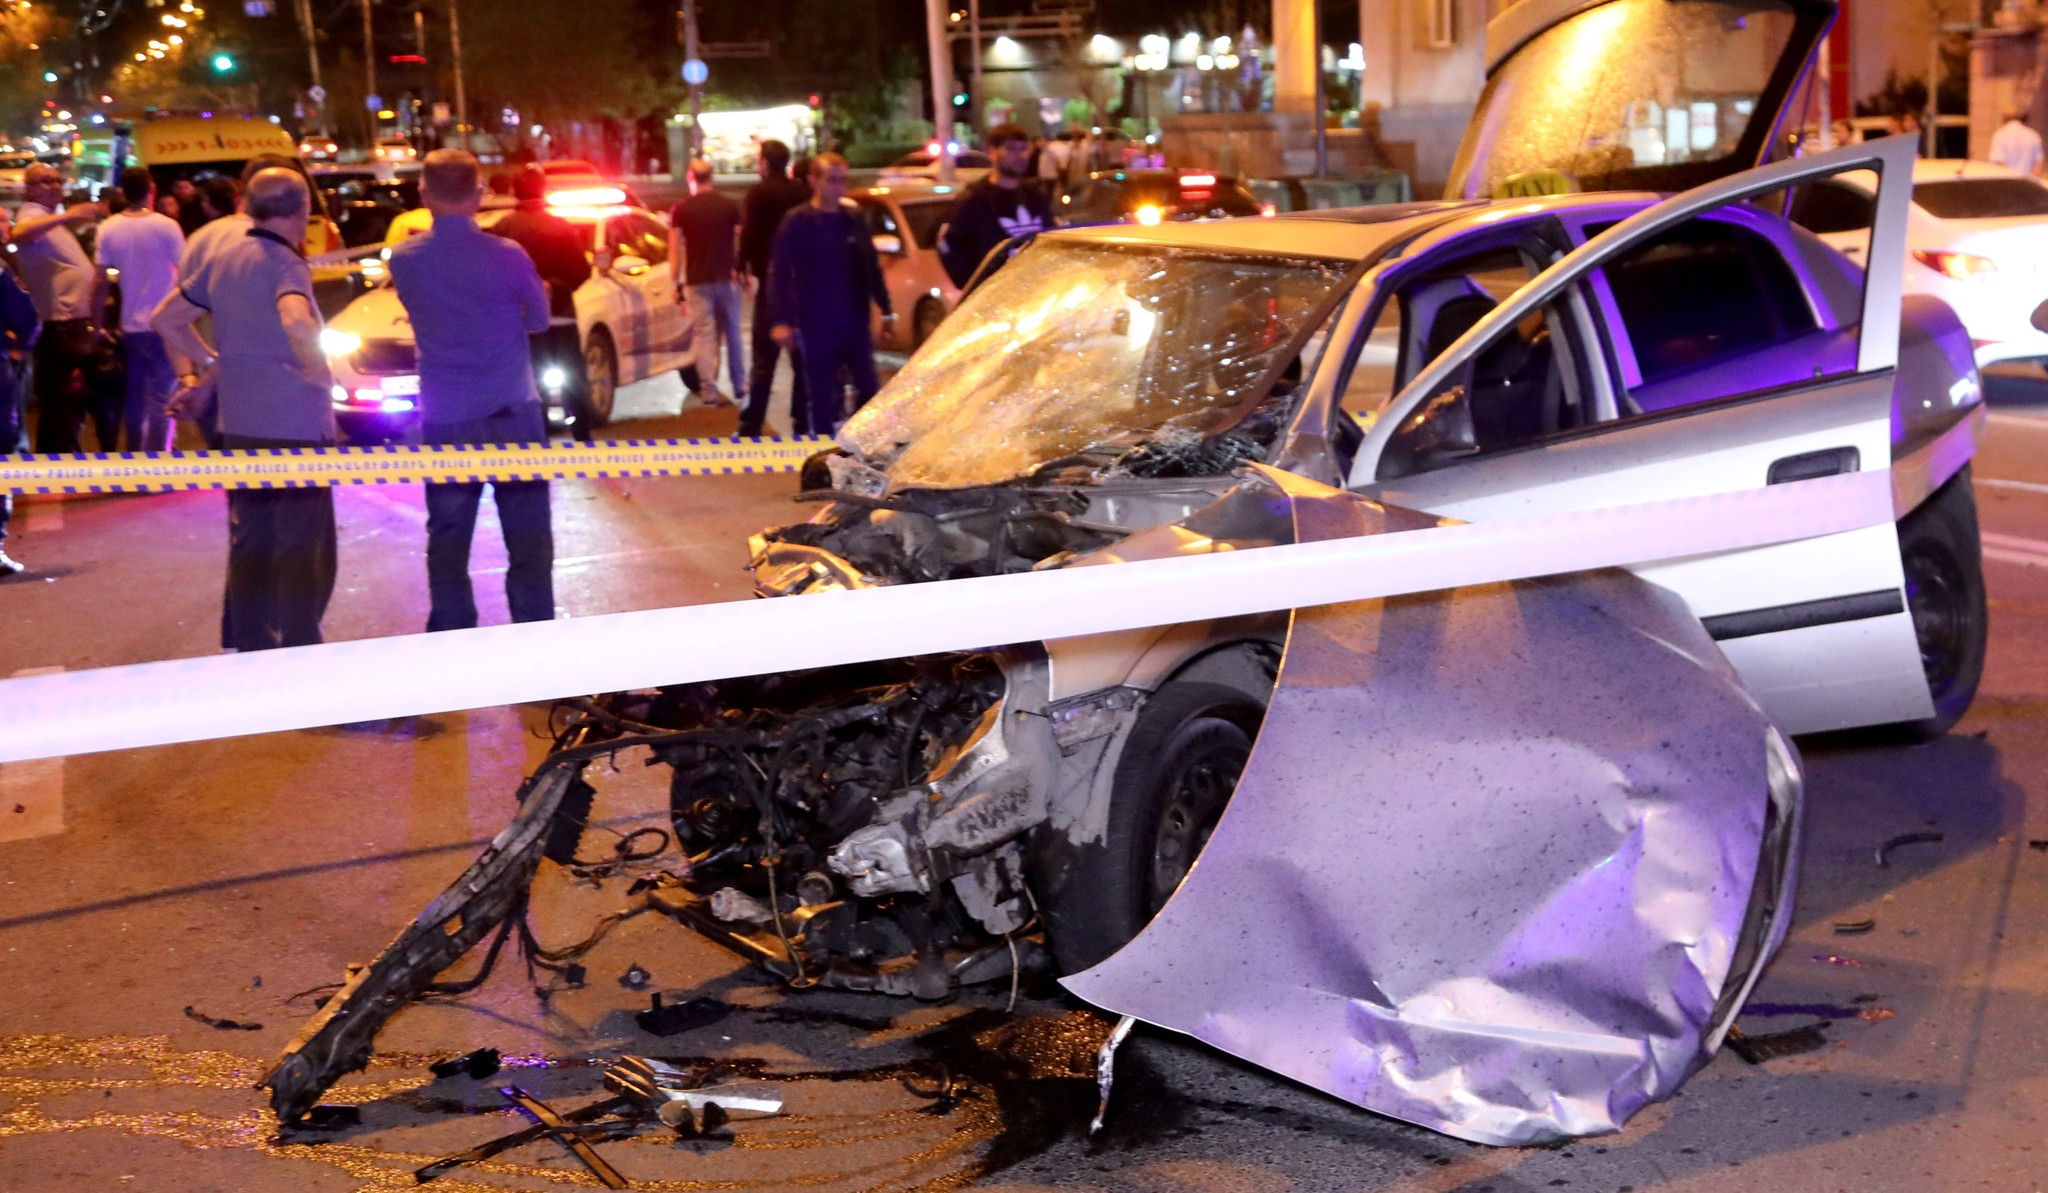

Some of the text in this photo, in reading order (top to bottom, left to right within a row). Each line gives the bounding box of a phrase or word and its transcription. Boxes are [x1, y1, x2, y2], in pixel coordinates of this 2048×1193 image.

[47, 468, 94, 478] POLICE
[245, 463, 289, 473] POLICE
[431, 459, 472, 468] POLICE
[606, 453, 645, 463] POLICE
[772, 448, 809, 458] POLICE
